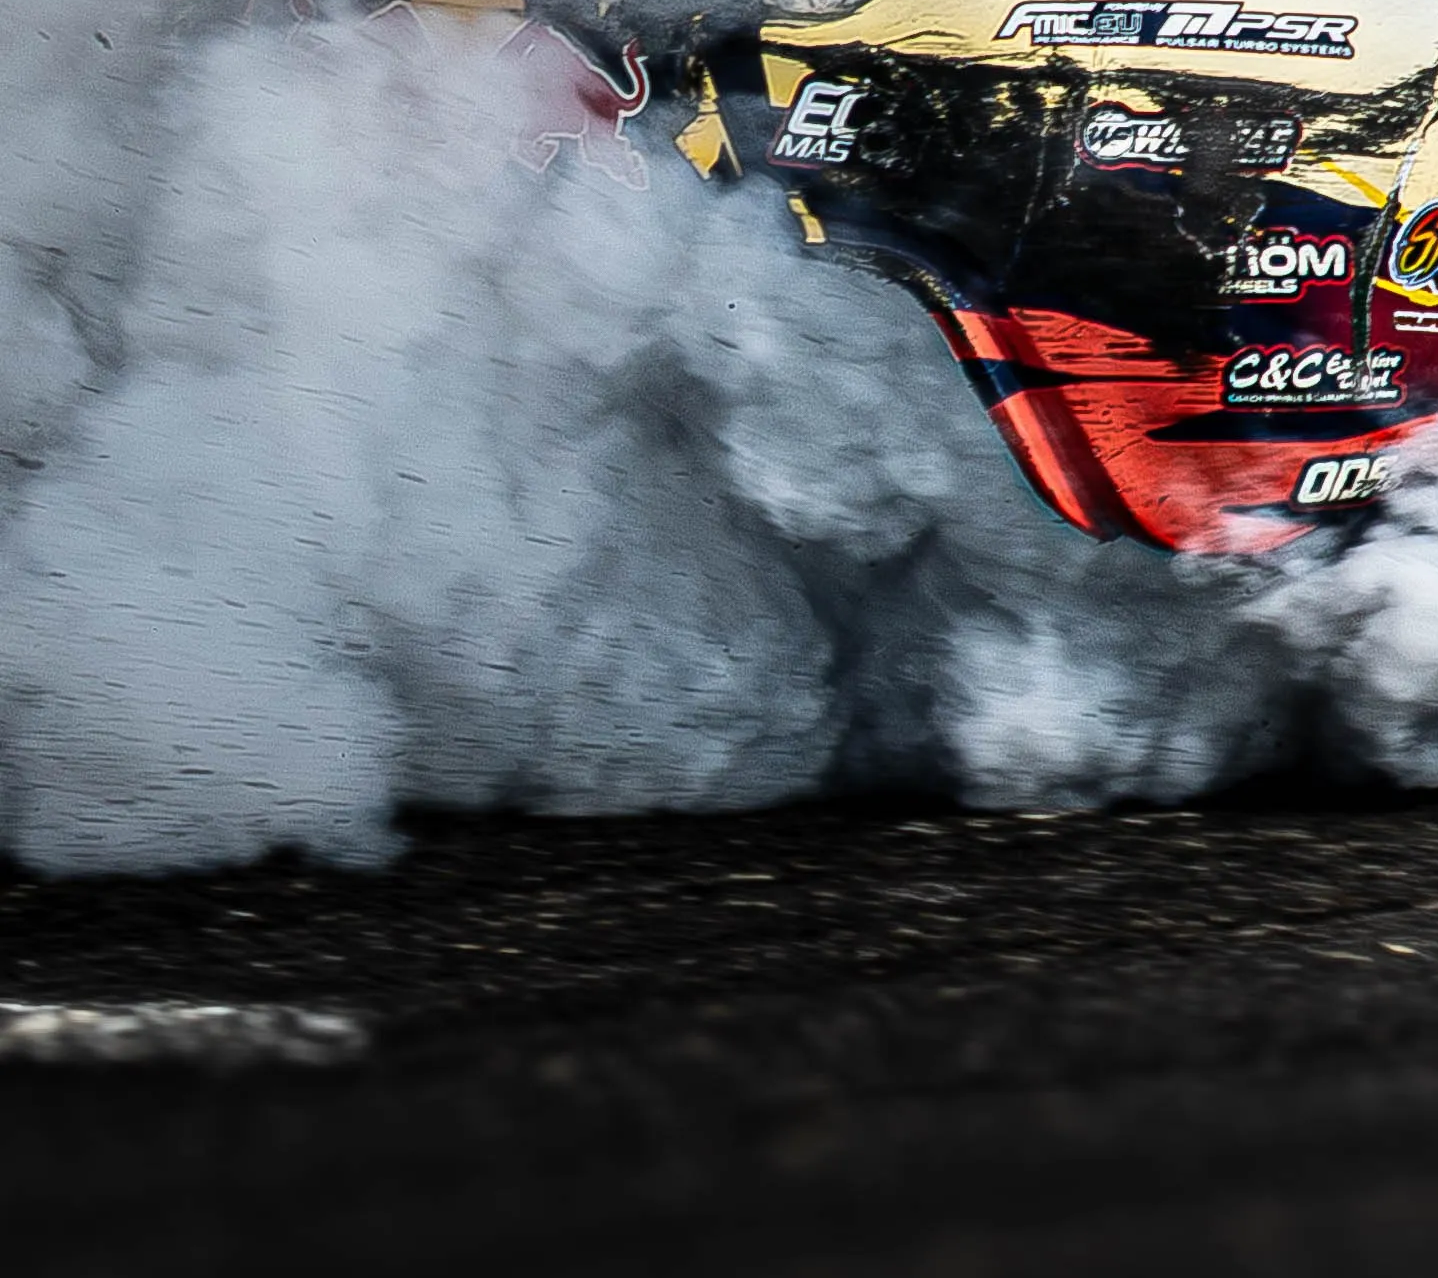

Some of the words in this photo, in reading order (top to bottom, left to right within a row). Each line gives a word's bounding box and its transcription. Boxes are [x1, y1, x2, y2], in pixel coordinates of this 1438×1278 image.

[1231, 14, 1357, 42] PSR
[1155, 36, 1221, 49] PULSAR
[1224, 38, 1279, 53] TURBO
[1279, 41, 1353, 57] SYSTEMS
[787, 81, 869, 137] EC
[774, 133, 855, 163] MAS
[1228, 352, 1325, 391] C&C
